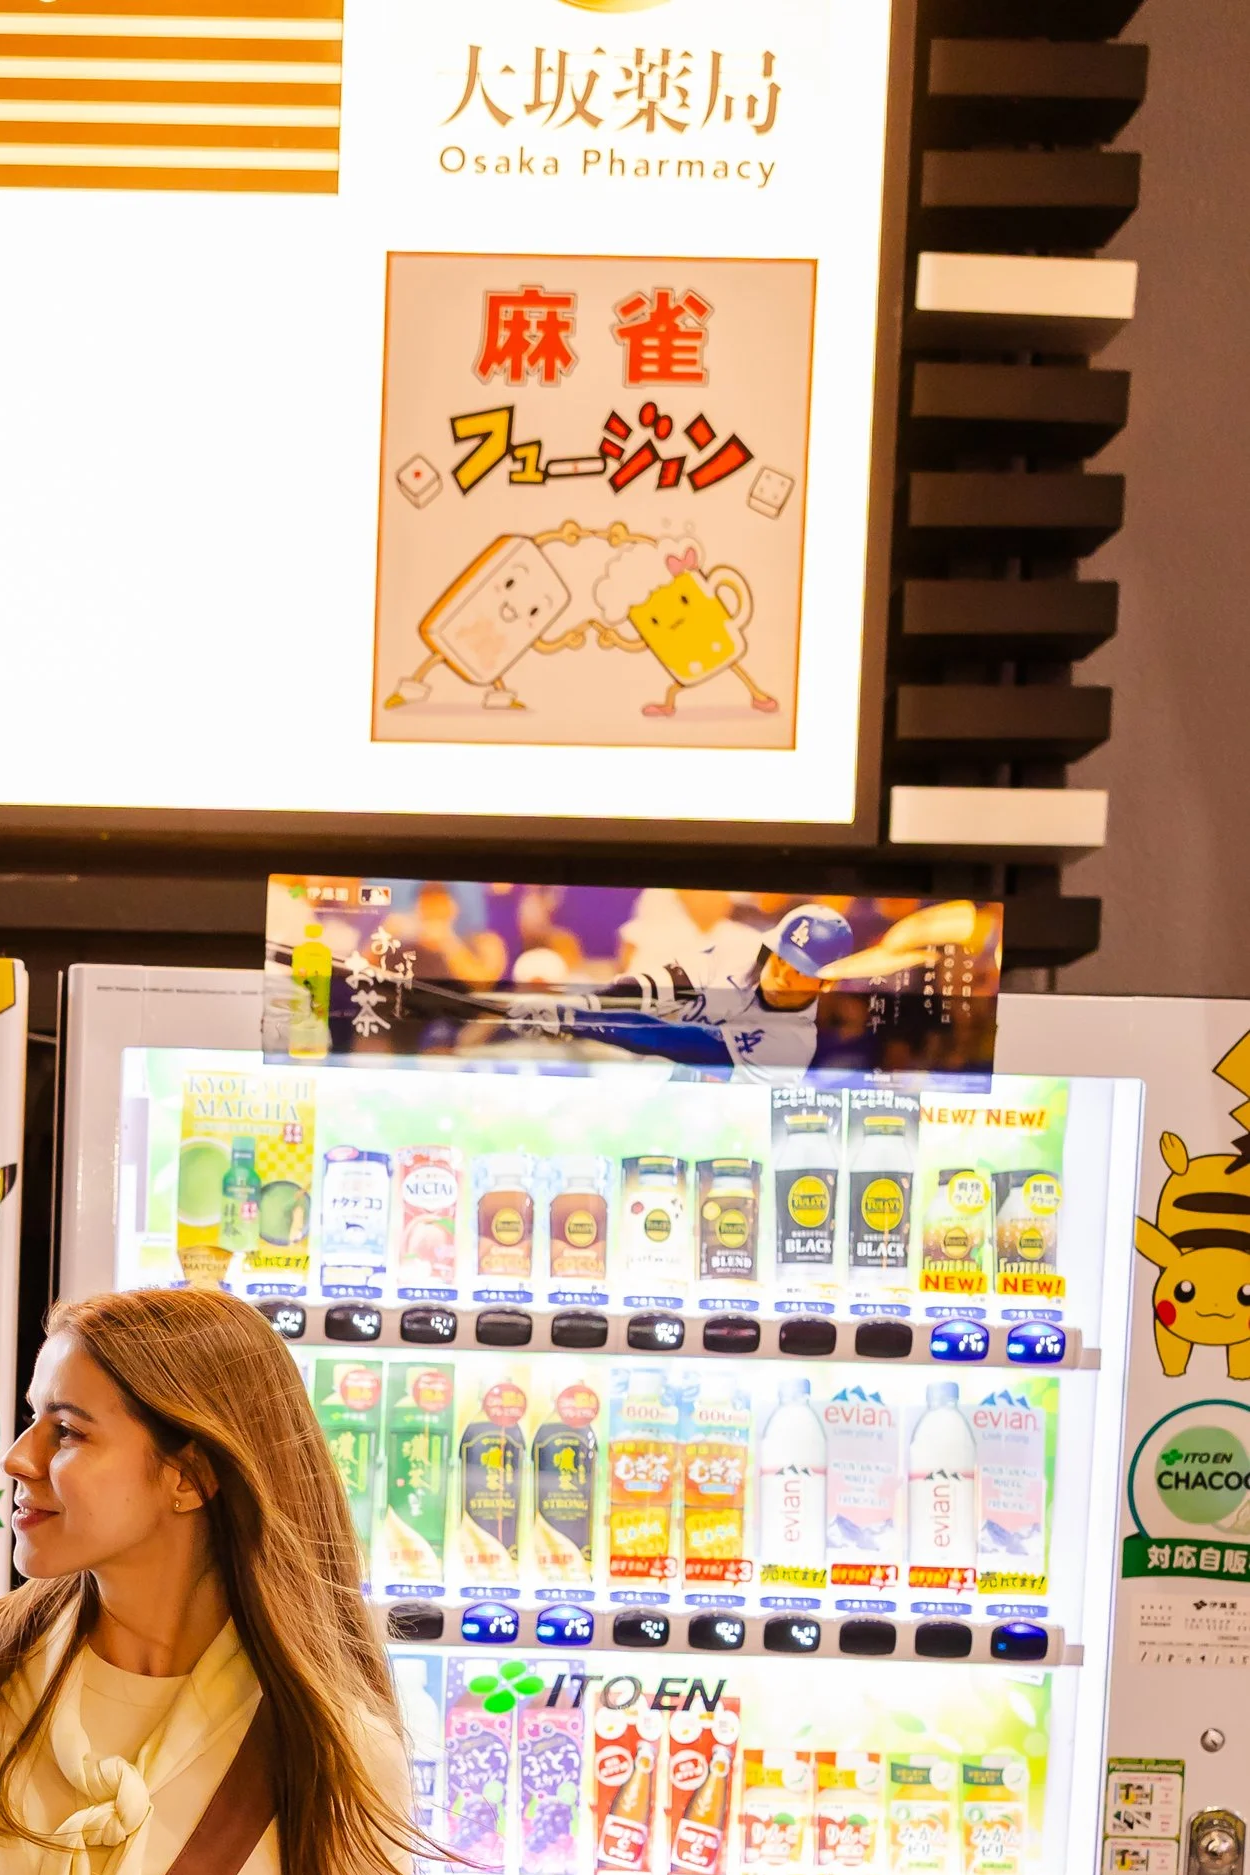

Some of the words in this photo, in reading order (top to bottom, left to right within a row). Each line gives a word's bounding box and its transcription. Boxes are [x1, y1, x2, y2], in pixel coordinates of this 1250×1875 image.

[440, 45, 782, 135] 大坂薬局
[439, 146, 561, 177] Osaka
[582, 150, 777, 188] Pharmacy
[472, 284, 714, 388] 麻雀
[196, 1098, 299, 1122] MATCHA
[919, 1105, 975, 1125] NEW!
[985, 1107, 1045, 1127] NEW!
[785, 1238, 833, 1255] BLACK
[856, 1241, 906, 1258] BLACK
[710, 1256, 752, 1270] BLEND
[924, 1274, 984, 1292] NEW!
[1002, 1277, 1063, 1296] NEW!
[824, 1403, 893, 1429] evian
[973, 1407, 1037, 1431] evian
[614, 1454, 671, 1482] むぎ茶
[689, 1456, 743, 1485] むぎ茶
[1183, 1452, 1210, 1465] ITO
[1212, 1453, 1233, 1465] EN
[783, 1479, 800, 1542] evian
[933, 1482, 951, 1548] evian
[1147, 1544, 1250, 1575] 対応自販
[545, 1673, 642, 1710] ITO
[650, 1677, 727, 1712] EN
